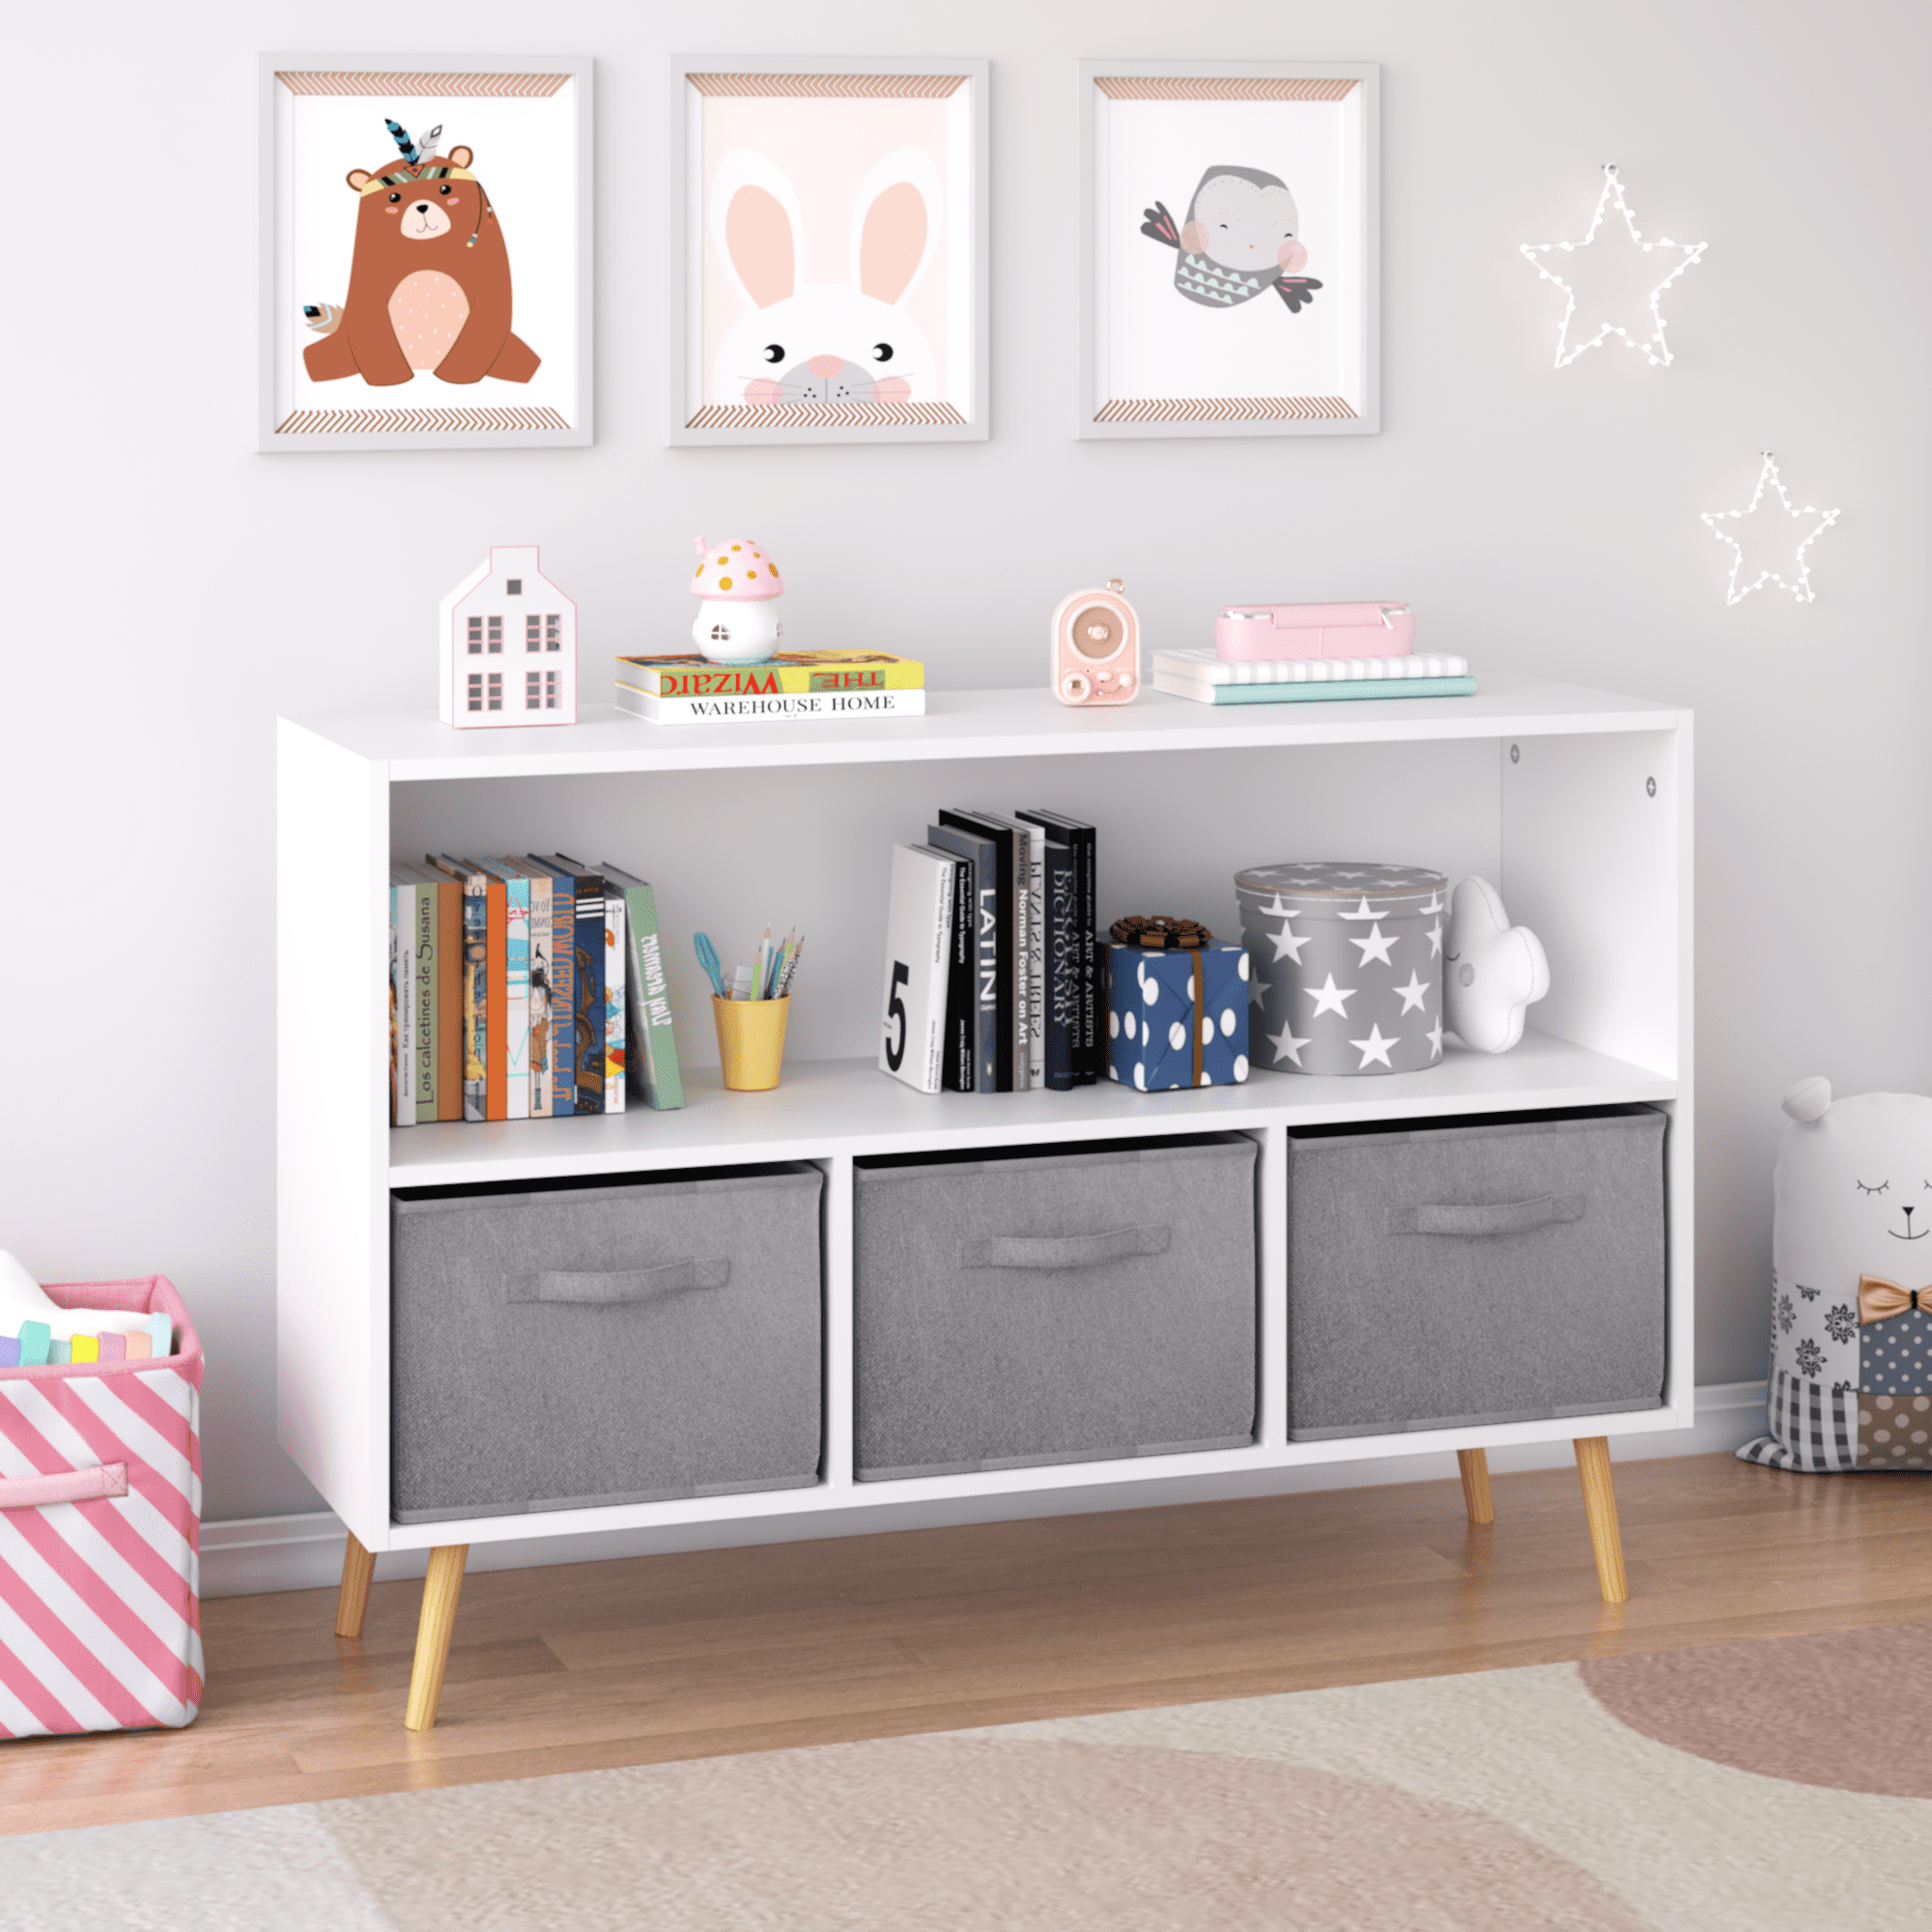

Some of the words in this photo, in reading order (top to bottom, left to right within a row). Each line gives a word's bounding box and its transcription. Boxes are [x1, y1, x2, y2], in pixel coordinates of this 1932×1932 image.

[811, 671, 885, 689] THE
[691, 698, 822, 715] WAREHOUSE
[832, 696, 895, 711] HOME
[1017, 834, 1029, 886] Moving
[415, 896, 433, 961] Susana
[1018, 889, 1029, 947] Norman
[980, 889, 996, 1001] LATIN
[1054, 870, 1065, 1023] DICTIONARY
[1085, 929, 1094, 962] ART
[415, 965, 431, 984] de
[1018, 951, 1029, 996] Foster
[415, 989, 432, 1068] calcetines
[885, 959, 909, 1072] 5
[1018, 1000, 1027, 1018] on
[1018, 1022, 1029, 1044] Art
[1085, 981, 1094, 1048] ARTISTS
[415, 1072, 434, 1105] Los
